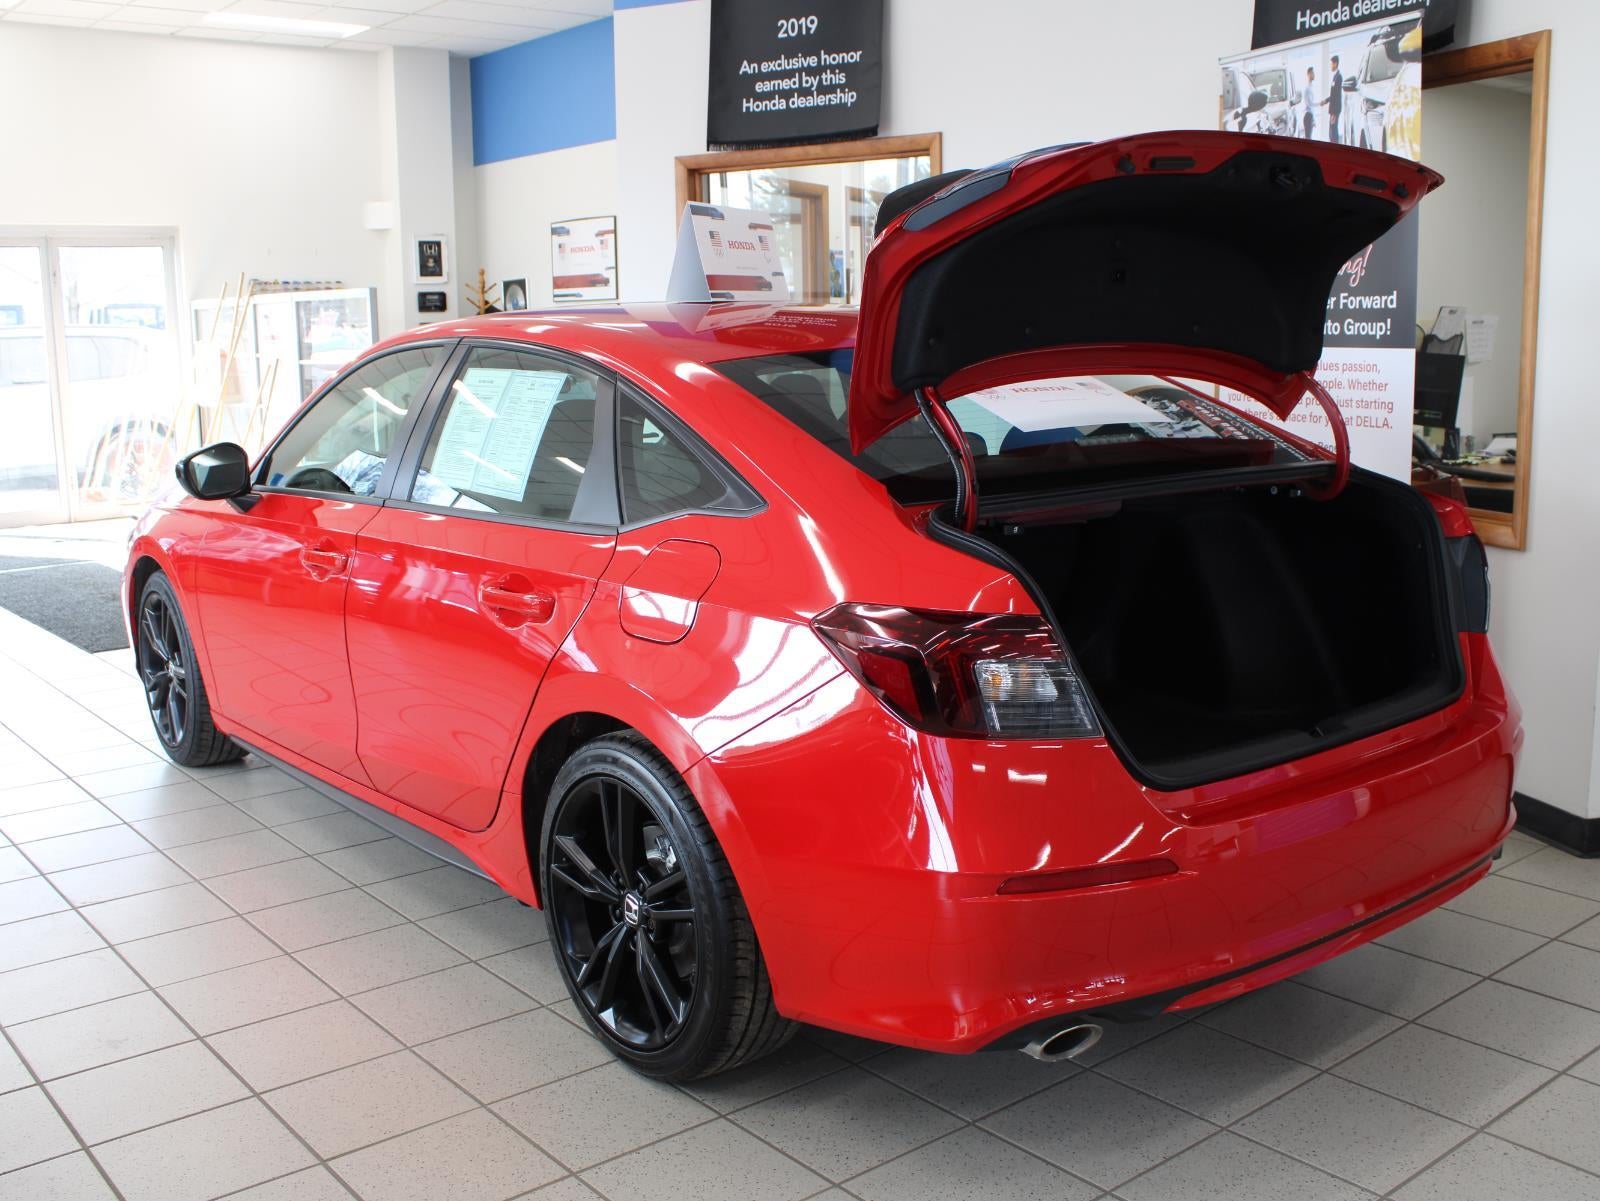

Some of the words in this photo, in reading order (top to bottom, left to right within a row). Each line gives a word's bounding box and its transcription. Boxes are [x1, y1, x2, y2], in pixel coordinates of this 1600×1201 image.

[1296, 1, 1350, 30] Honda
[777, 15, 818, 38] 2019
[739, 60, 758, 75] An
[761, 54, 818, 73] exclusive
[821, 50, 862, 67] honor
[755, 73, 799, 93] earned
[802, 72, 819, 91] by
[821, 69, 846, 87] this
[742, 94, 786, 112] Honda
[789, 89, 857, 109] dealership
[727, 240, 756, 250] HONDA
[1339, 290, 1397, 309] Forward
[1344, 318, 1391, 340] Group!
[1342, 360, 1381, 374] passion,
[1347, 379, 1389, 393] Whether
[1355, 398, 1394, 414] starting
[1309, 411, 1322, 424] for
[1356, 415, 1393, 429] DELLA.
